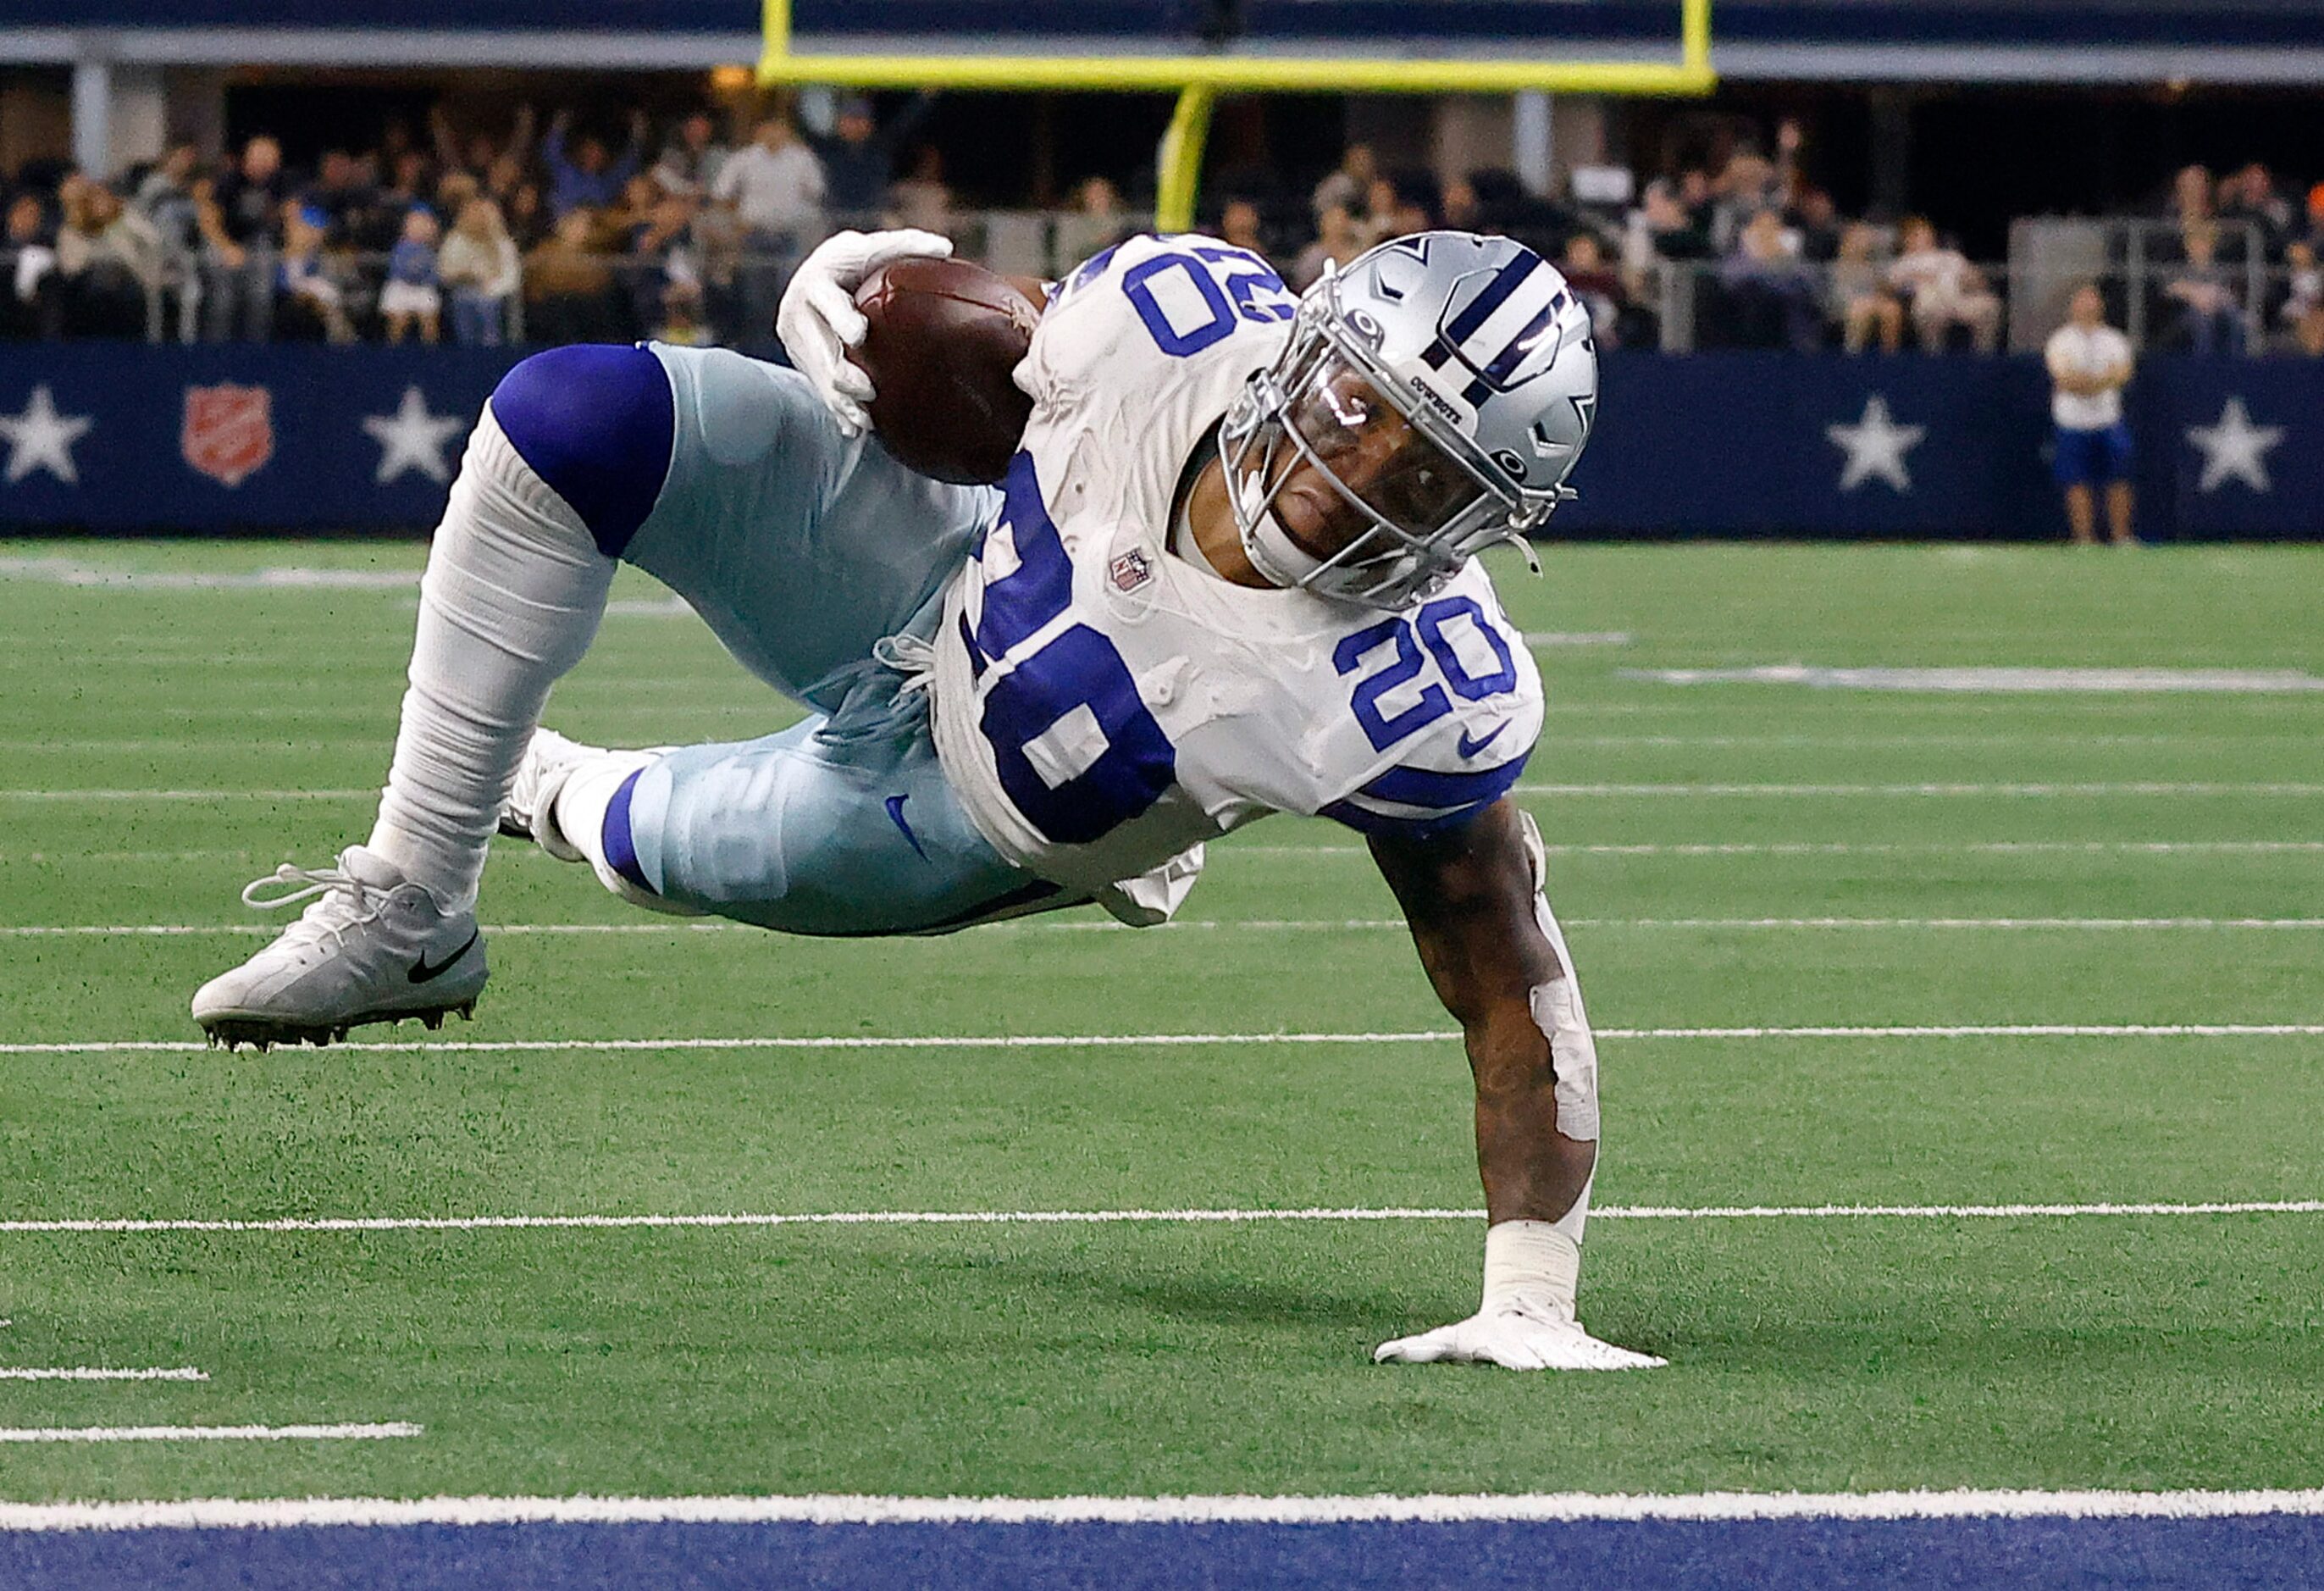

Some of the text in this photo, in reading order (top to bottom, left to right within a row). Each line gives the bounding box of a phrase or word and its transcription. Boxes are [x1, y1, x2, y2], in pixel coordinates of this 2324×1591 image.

[1121, 247, 1296, 358] 20
[1410, 375, 1463, 424] COWBOYS
[959, 447, 1176, 843] 20
[1332, 596, 1517, 753] 20
